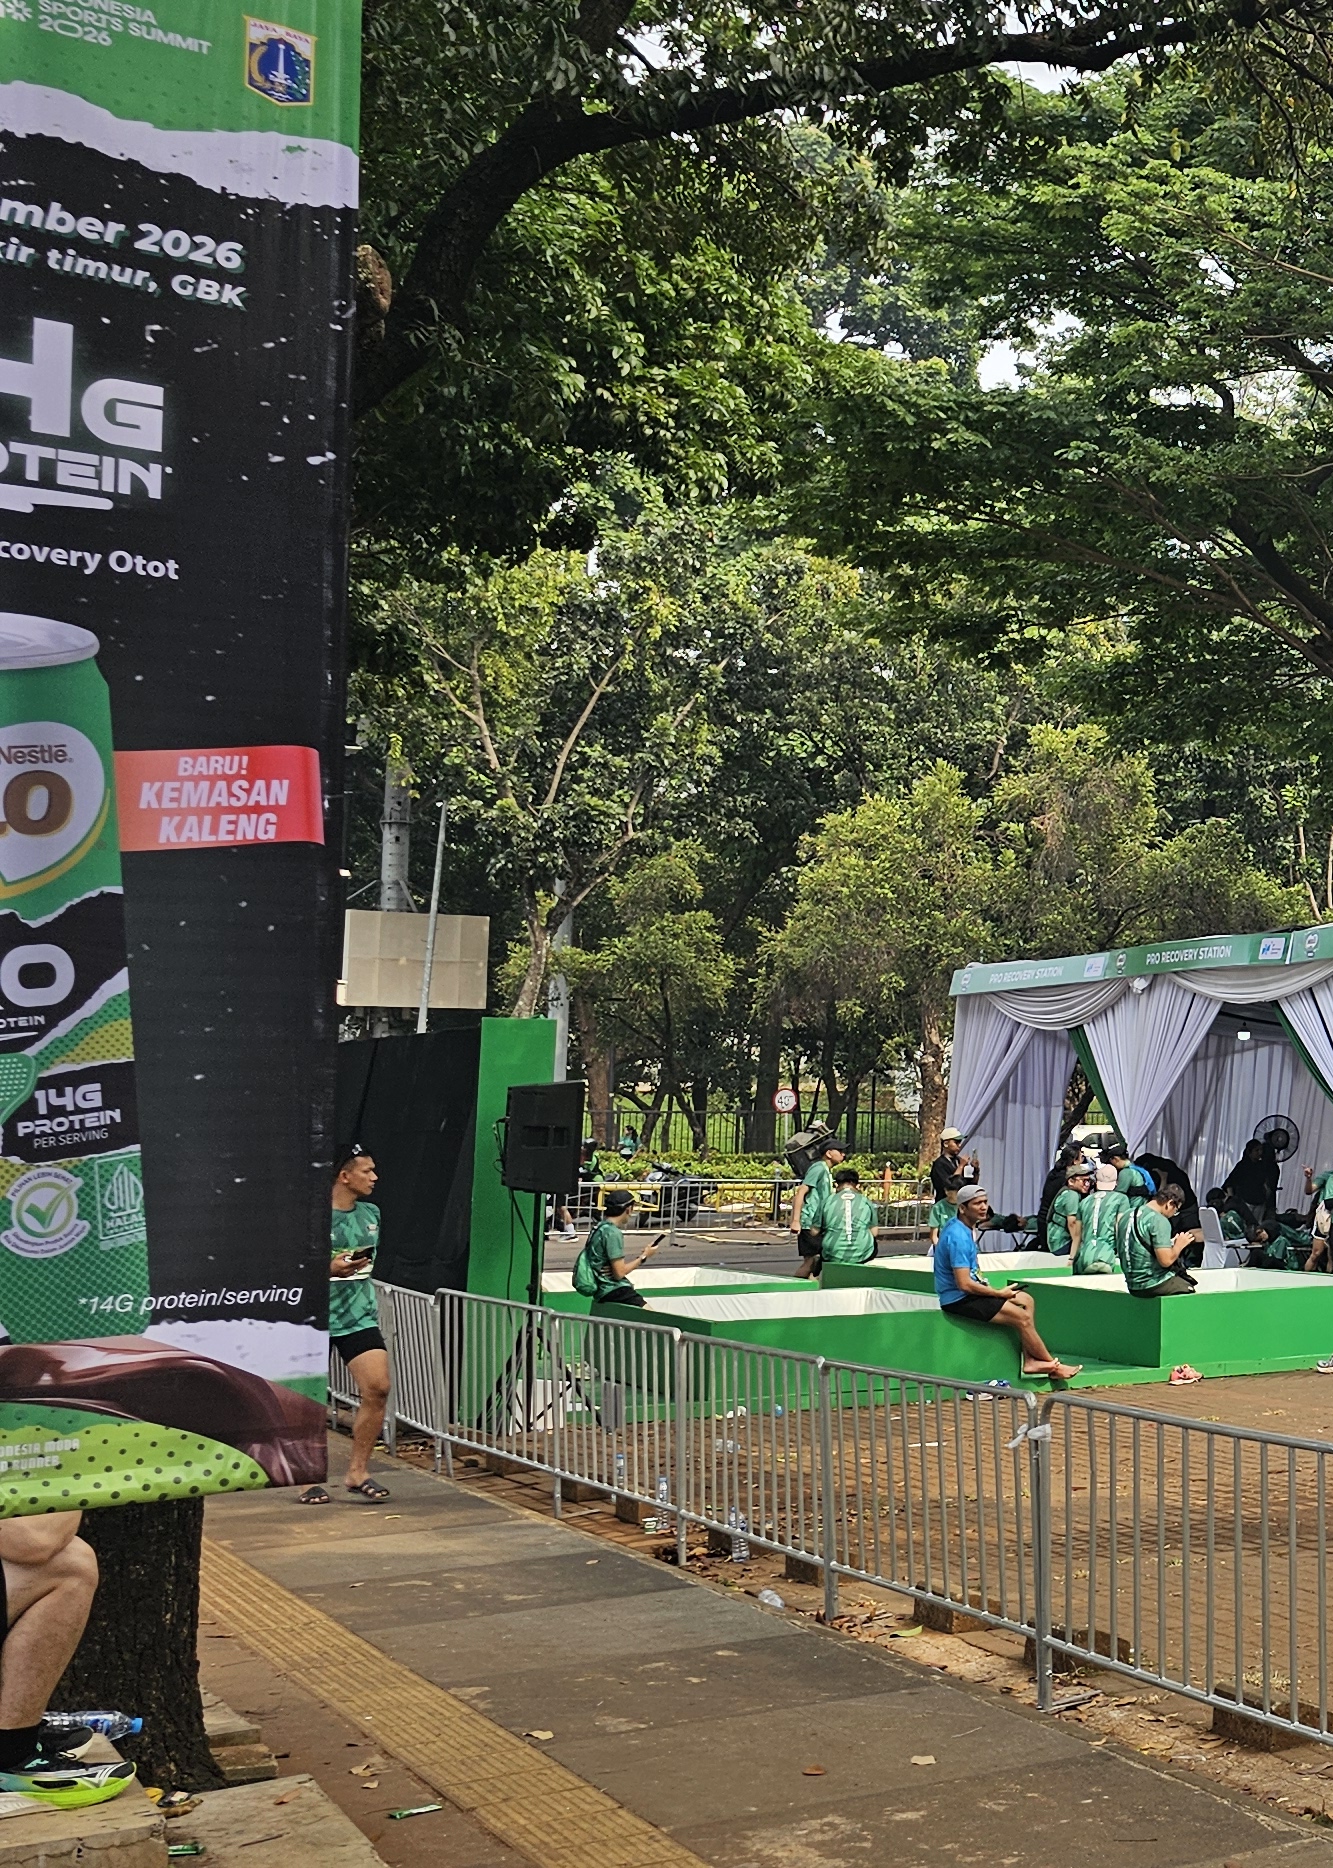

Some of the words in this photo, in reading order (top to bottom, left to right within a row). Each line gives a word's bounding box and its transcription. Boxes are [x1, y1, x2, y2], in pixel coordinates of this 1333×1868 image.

[38, 0, 124, 33] SPORTS
[127, 21, 212, 55] SUMMIT
[134, 223, 243, 270] 2026
[46, 248, 157, 294] timur,
[171, 274, 246, 308] GBK
[109, 550, 179, 581] Otot
[177, 755, 249, 777] BARU!
[139, 779, 289, 810] KEMASAN
[158, 813, 278, 844] KALENG
[1146, 953, 1160, 965] PRO
[1161, 948, 1199, 963] RECOVERY
[1199, 945, 1232, 960] STATION
[34, 1083, 103, 1115] 14G
[17, 1109, 121, 1137] PROTEIN
[33, 1137, 57, 1149] PER
[58, 1128, 109, 1146] SERVING
[140, 1285, 303, 1316] protein/serving
